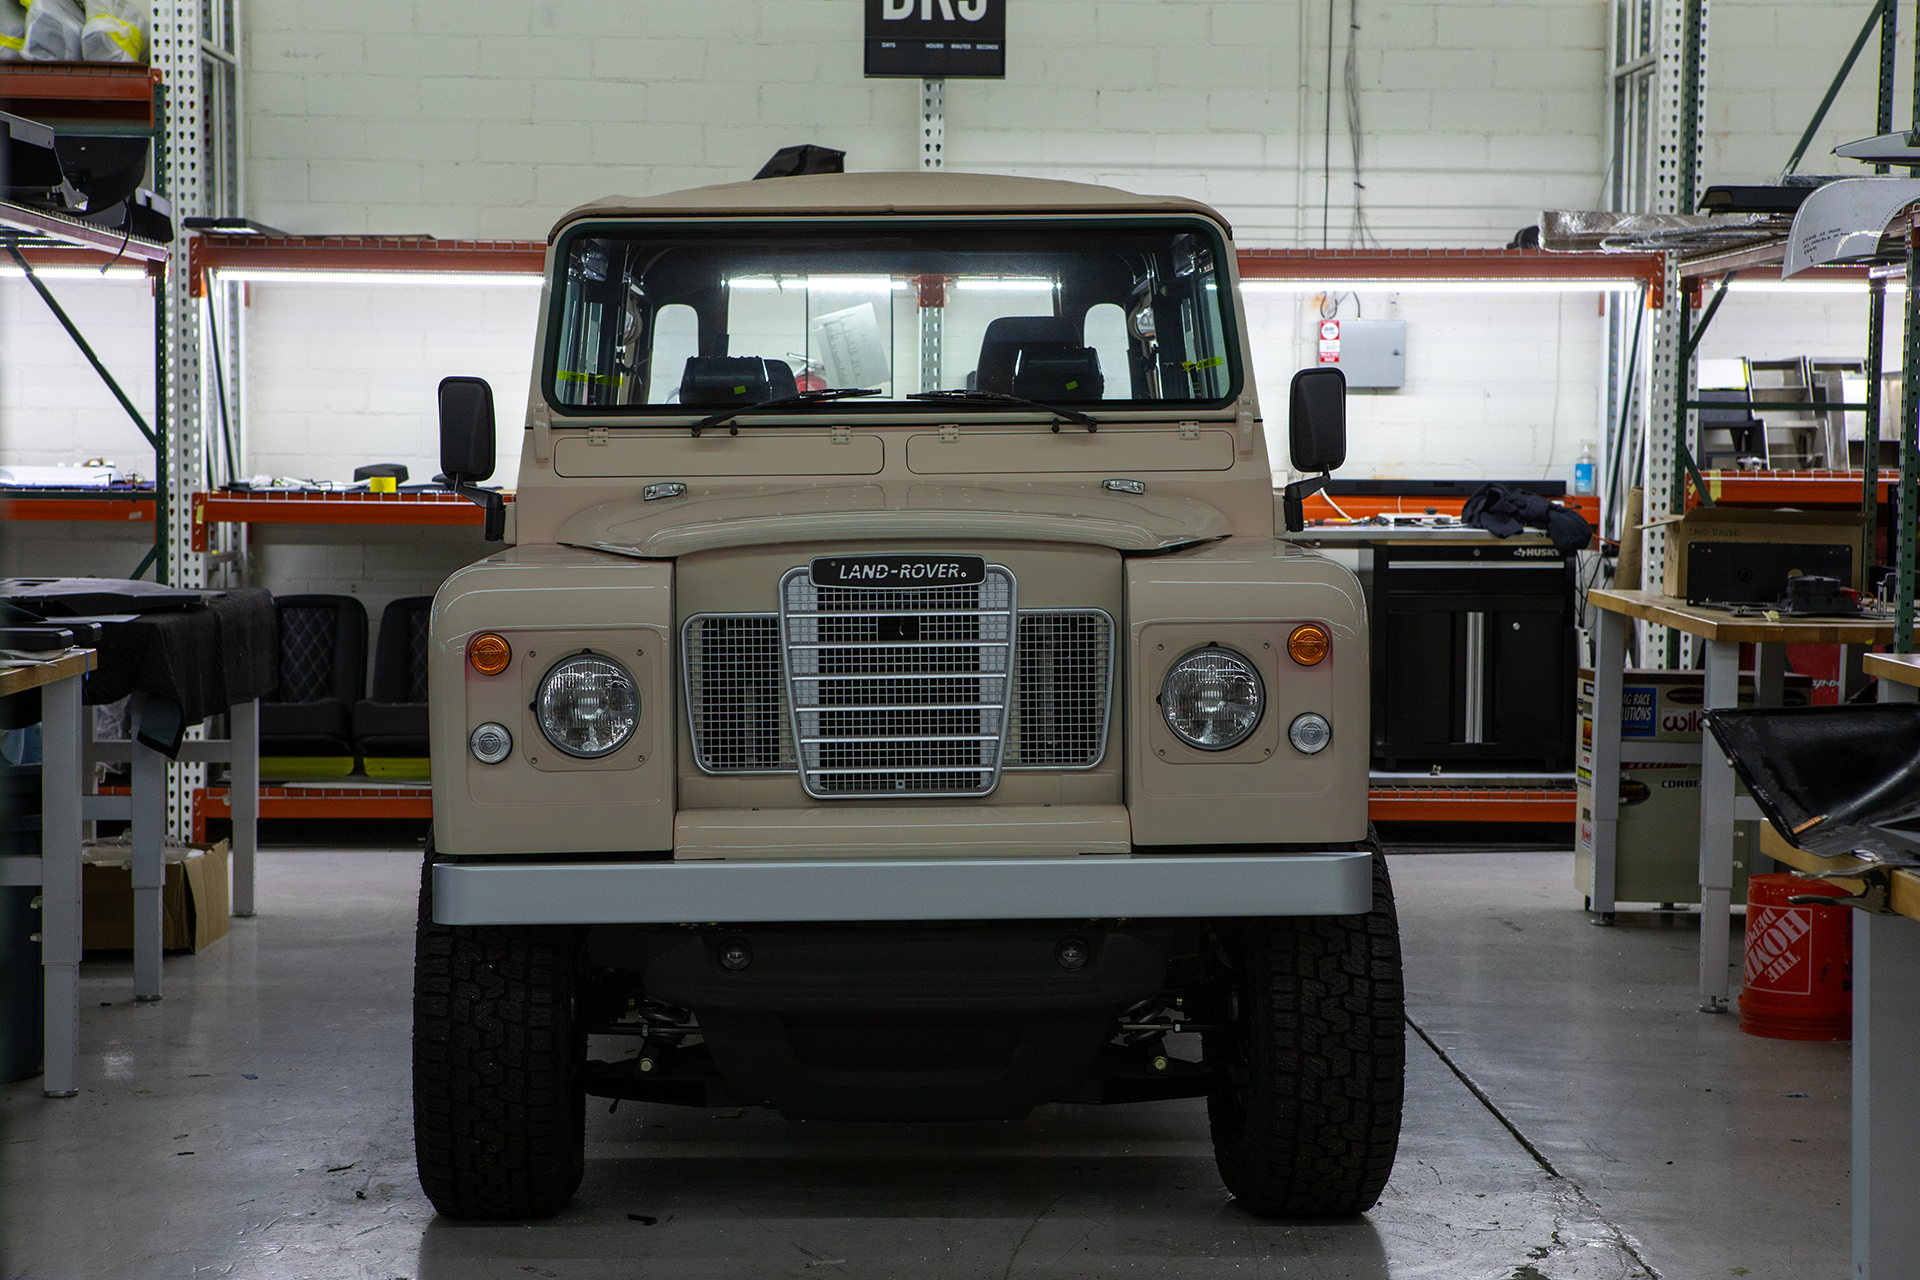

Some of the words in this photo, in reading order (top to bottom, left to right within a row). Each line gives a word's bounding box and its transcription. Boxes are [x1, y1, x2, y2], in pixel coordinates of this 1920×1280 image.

[839, 563, 960, 580] LAND-ROVER
[1632, 693, 1651, 706] RACE
[1662, 710, 1703, 732] wil
[1745, 907, 1777, 952] DEPO
[1763, 950, 1802, 984] THE
